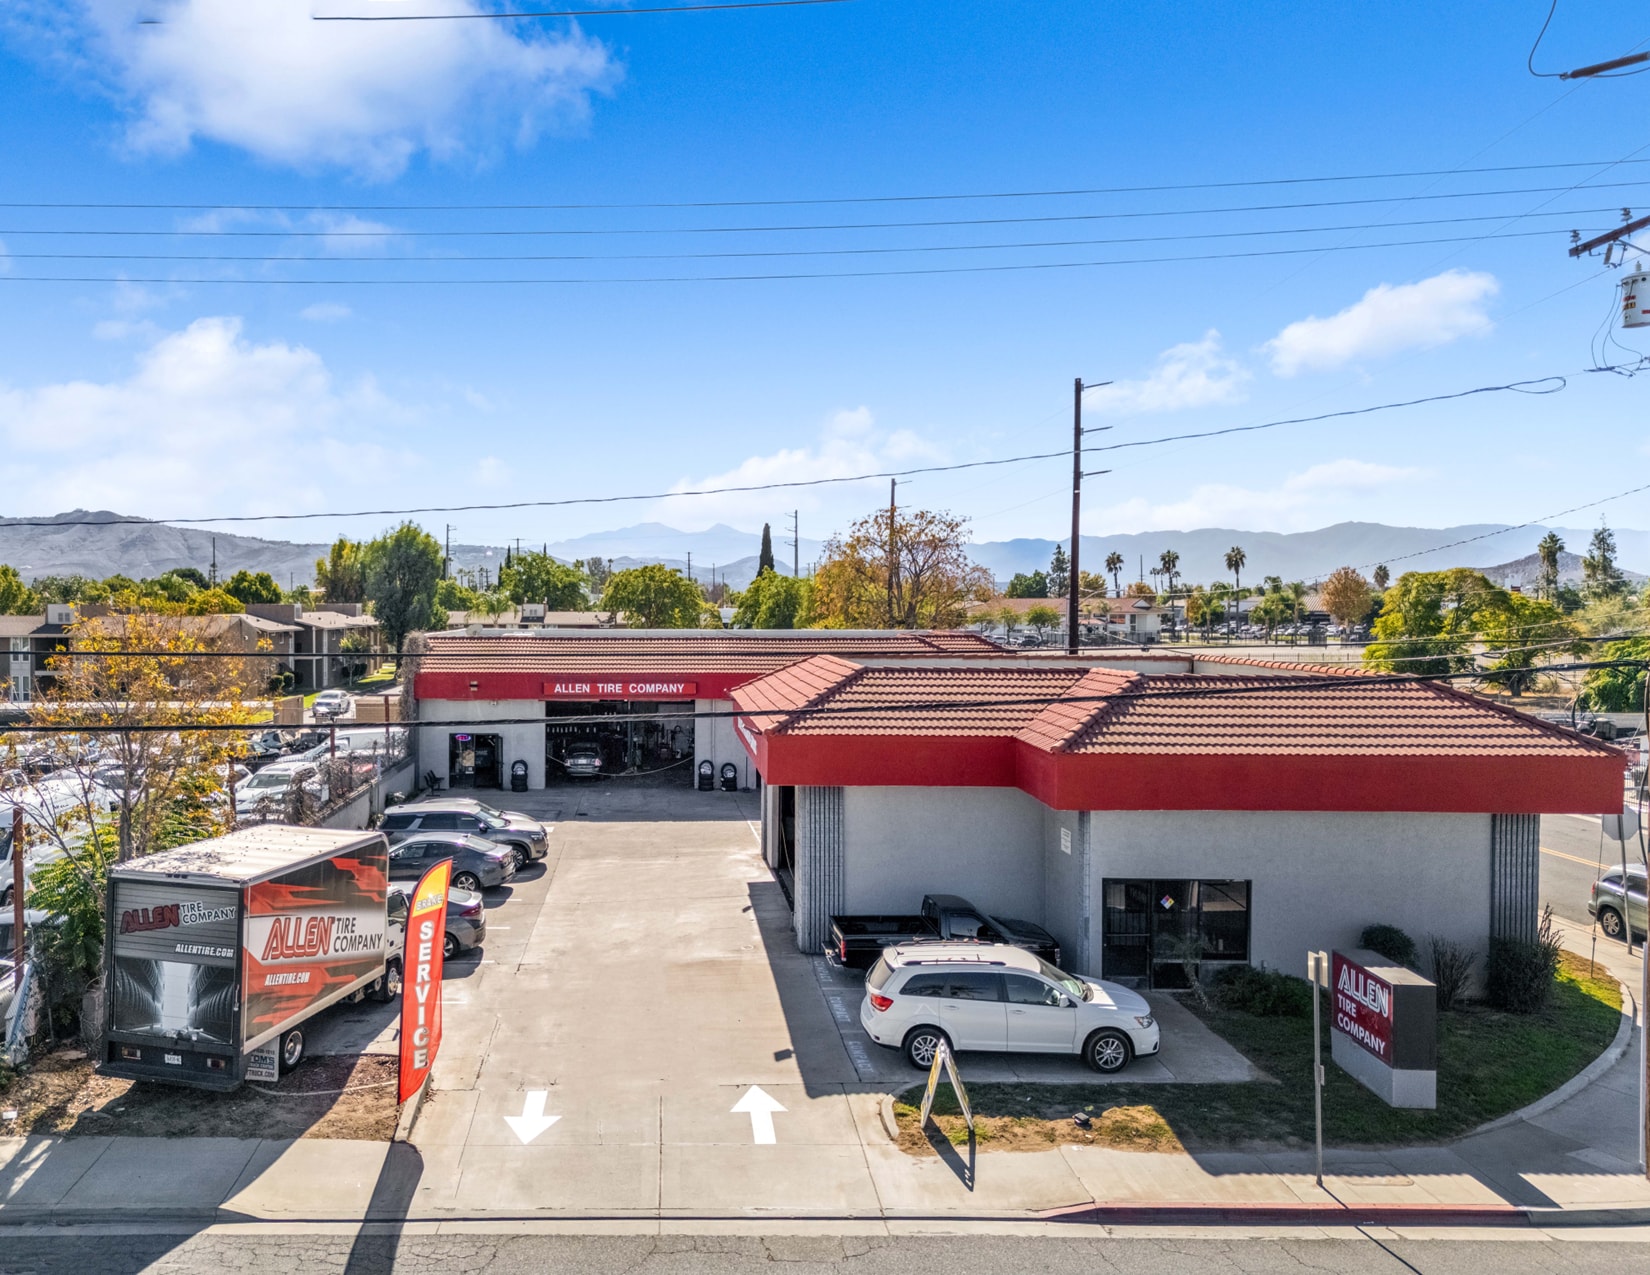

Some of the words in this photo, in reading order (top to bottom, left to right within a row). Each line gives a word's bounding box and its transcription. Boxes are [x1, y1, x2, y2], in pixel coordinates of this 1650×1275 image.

[554, 683, 590, 693] ALLEN
[597, 683, 623, 693] TIRE
[629, 683, 685, 693] COMPANY
[181, 902, 203, 914] TIRE
[416, 893, 443, 911] BRAKE
[120, 904, 181, 934] ALLEN
[182, 907, 236, 925] COMPANY
[336, 917, 356, 934] TIRE
[261, 916, 335, 960] ALLEN
[334, 933, 383, 953] COMPANY
[175, 943, 234, 958] ALLENTIRE.COM
[265, 972, 310, 986] ALLENTIRE.COM
[412, 920, 434, 1070] SERVICE
[1338, 964, 1388, 1018] ALLEN
[1337, 993, 1356, 1018] TIRE
[1337, 1013, 1385, 1055] COMPANY
